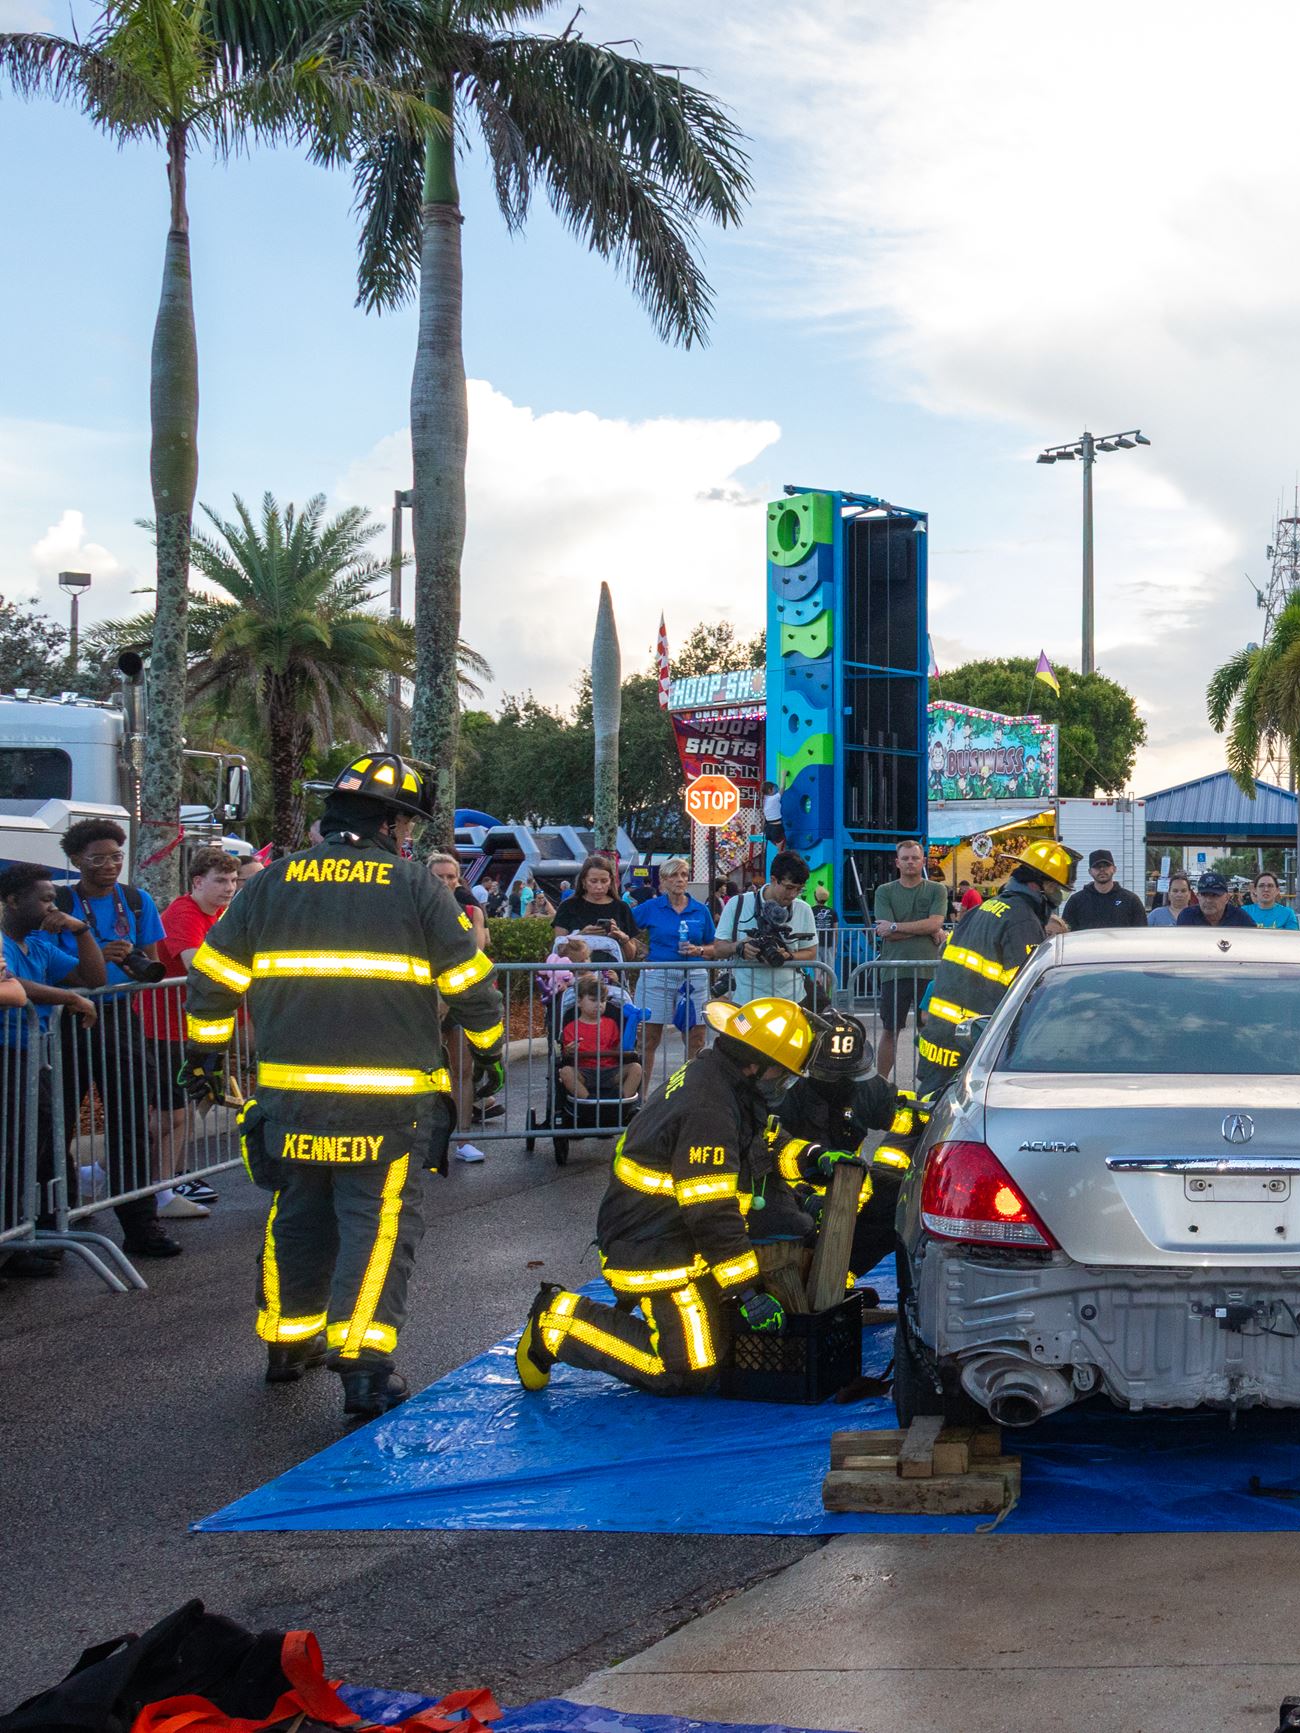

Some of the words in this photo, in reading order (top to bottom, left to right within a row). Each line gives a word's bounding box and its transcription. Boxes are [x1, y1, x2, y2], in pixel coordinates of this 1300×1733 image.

[700, 719, 758, 735] HOOP
[685, 737, 758, 757] SHOTS
[702, 762, 736, 776] ONE
[740, 764, 760, 779] IN
[947, 746, 1024, 777] BUSINESS
[690, 790, 736, 810] STOP
[285, 858, 394, 885] MARGATE
[831, 1035, 854, 1054] 18
[282, 1133, 384, 1163] KENNEDY
[689, 1145, 725, 1166] MFD
[1018, 1140, 1081, 1153] ACURA
